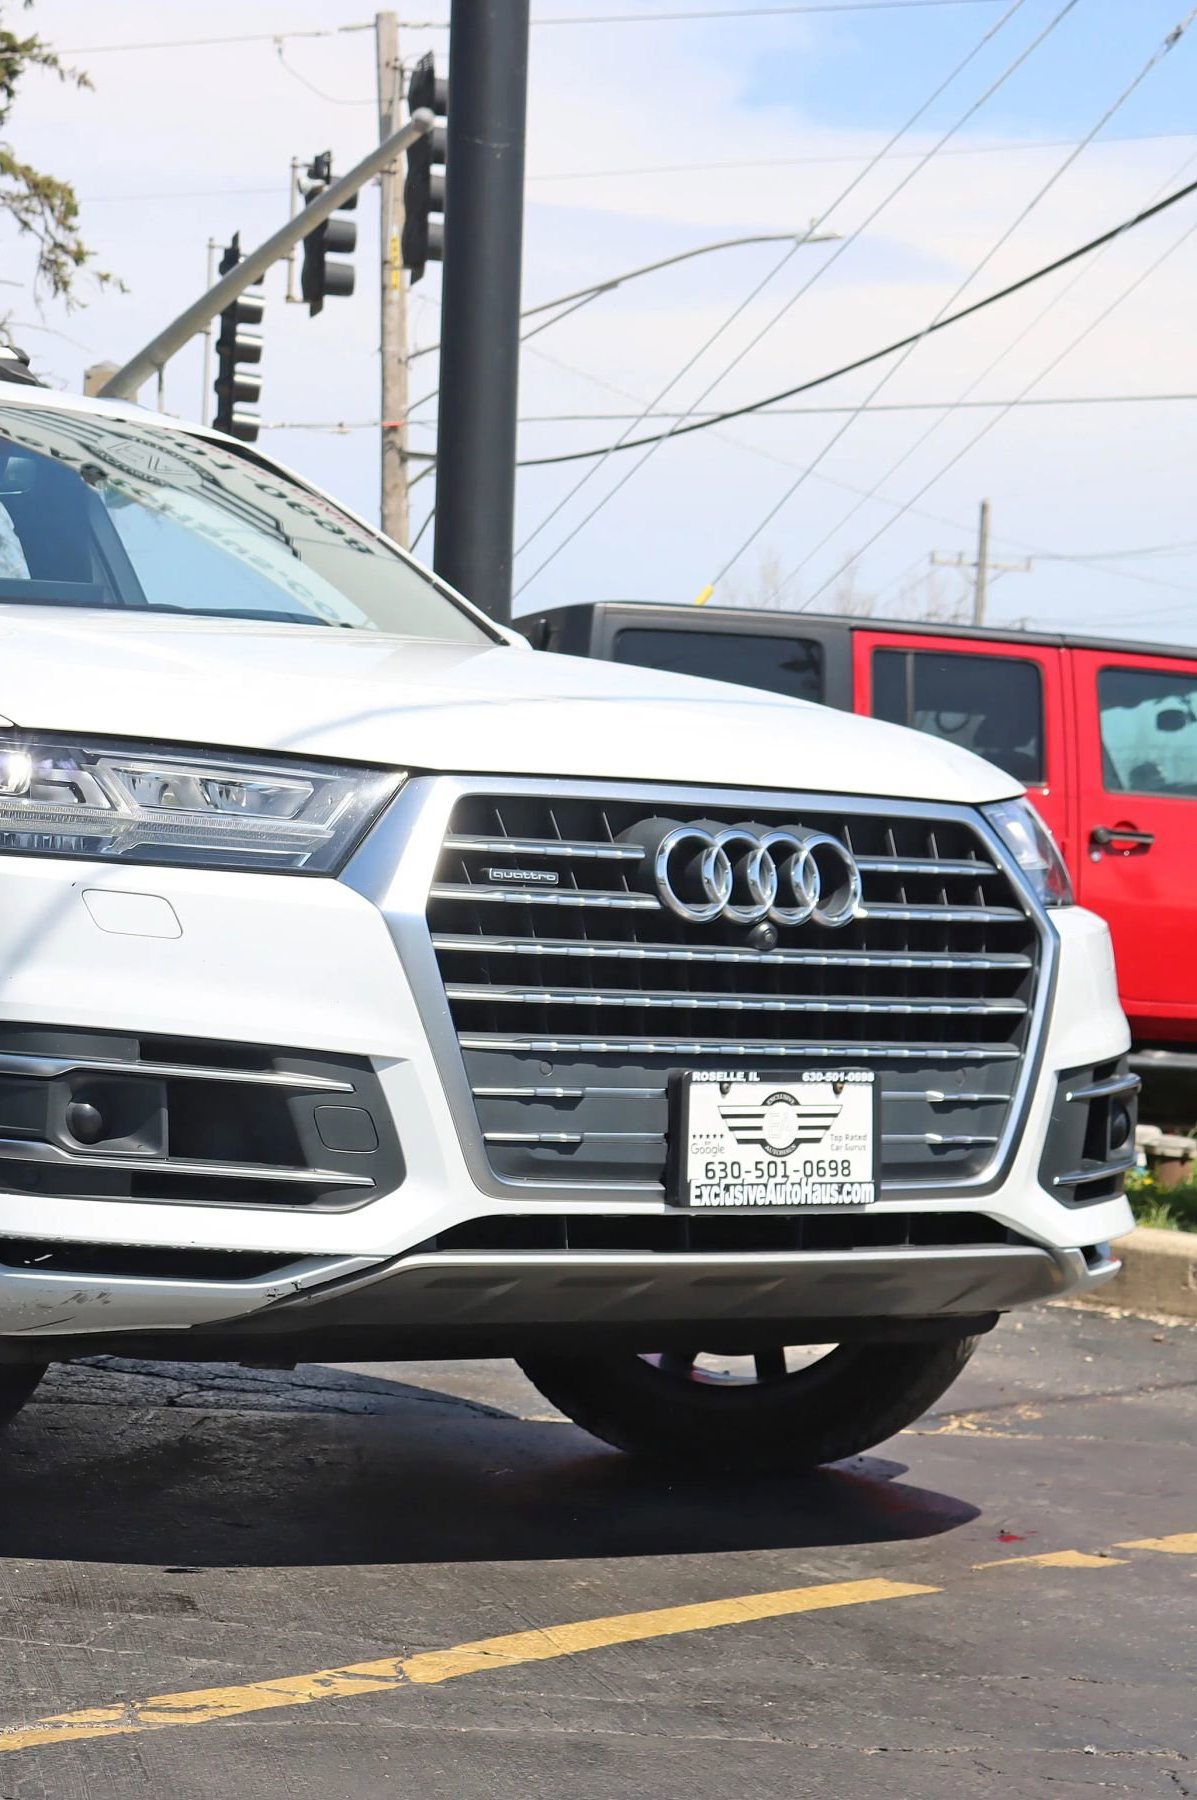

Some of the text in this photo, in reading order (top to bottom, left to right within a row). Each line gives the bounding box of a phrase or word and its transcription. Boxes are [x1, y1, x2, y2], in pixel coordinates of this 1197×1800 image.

[493, 871, 556, 881] quattro
[692, 1071, 760, 1082] ROSELLE, IL
[802, 1071, 875, 1082] 630-501-0698
[845, 1133, 868, 1141] Rated
[691, 1143, 725, 1157] Google
[705, 1159, 851, 1180] 630-501-0698
[689, 1178, 875, 1207] ExclusiveAutoHaus.com
